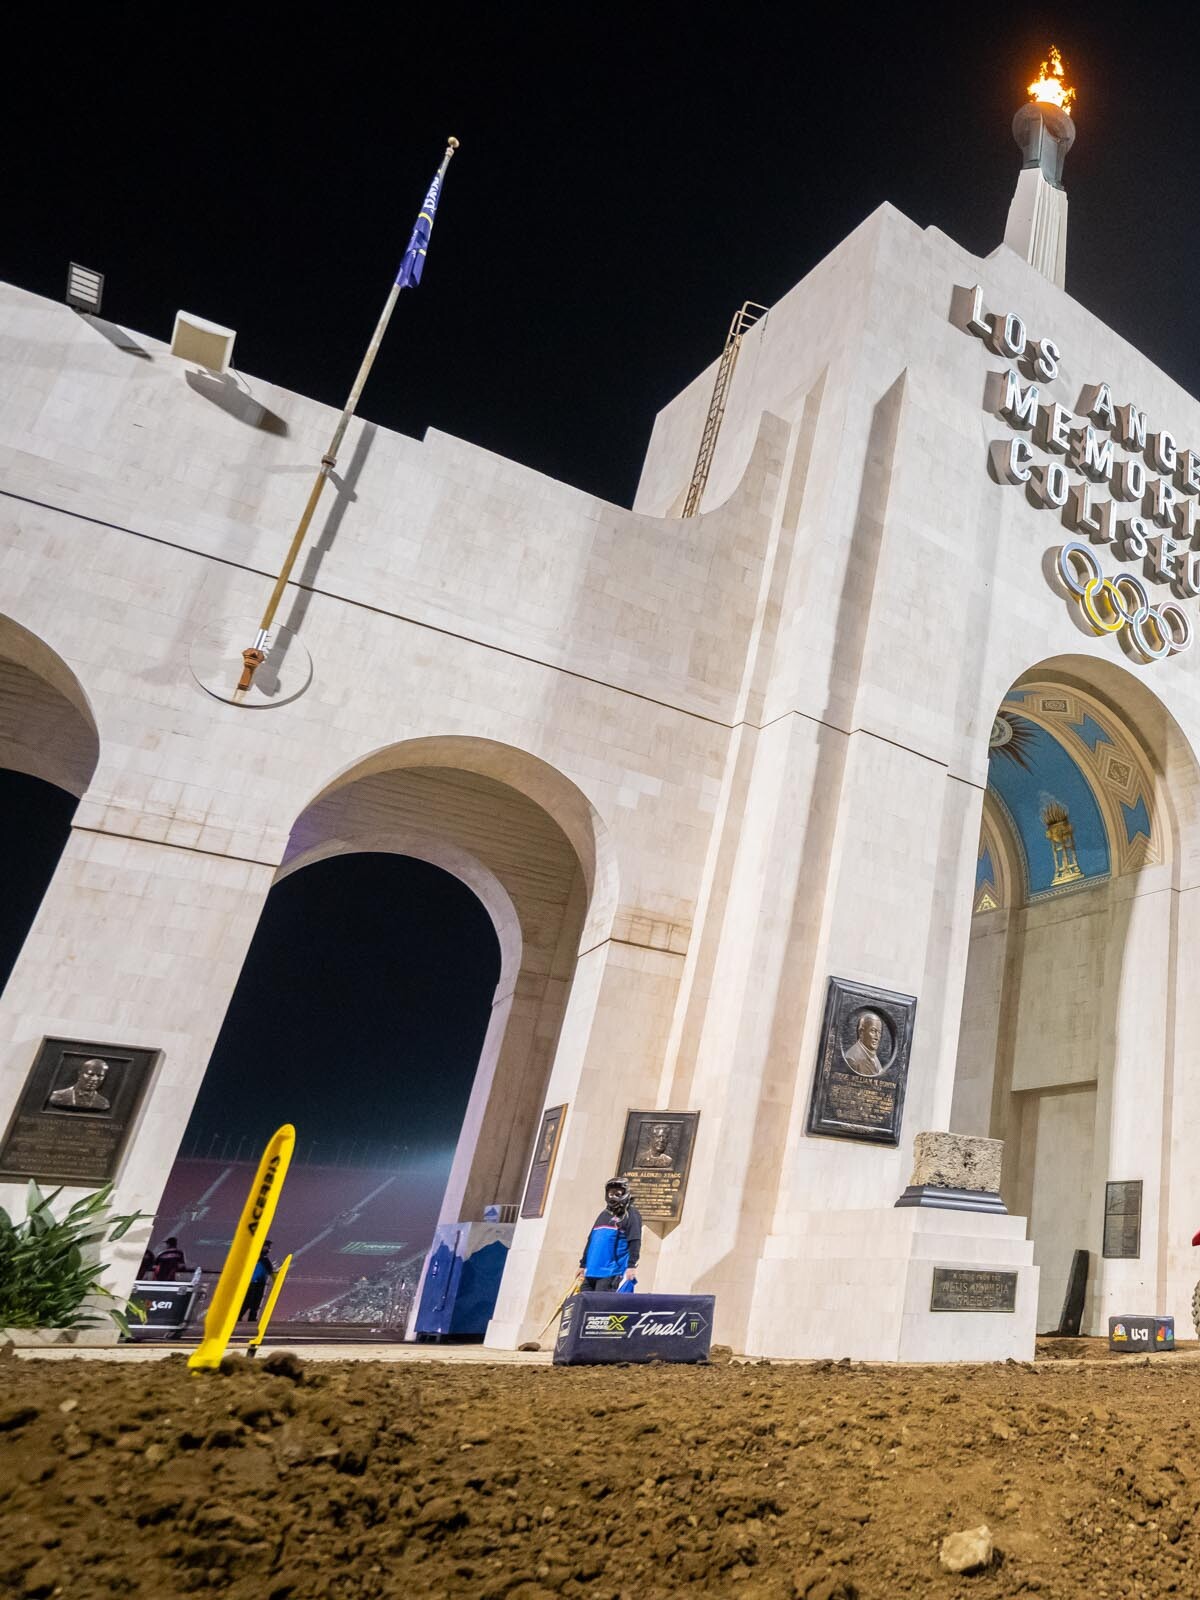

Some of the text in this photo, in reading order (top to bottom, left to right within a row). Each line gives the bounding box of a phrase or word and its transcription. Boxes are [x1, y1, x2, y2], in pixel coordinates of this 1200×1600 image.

[967, 284, 1061, 380] LOS
[248, 1156, 281, 1236] ACERBIS
[627, 1311, 687, 1338] Finals
